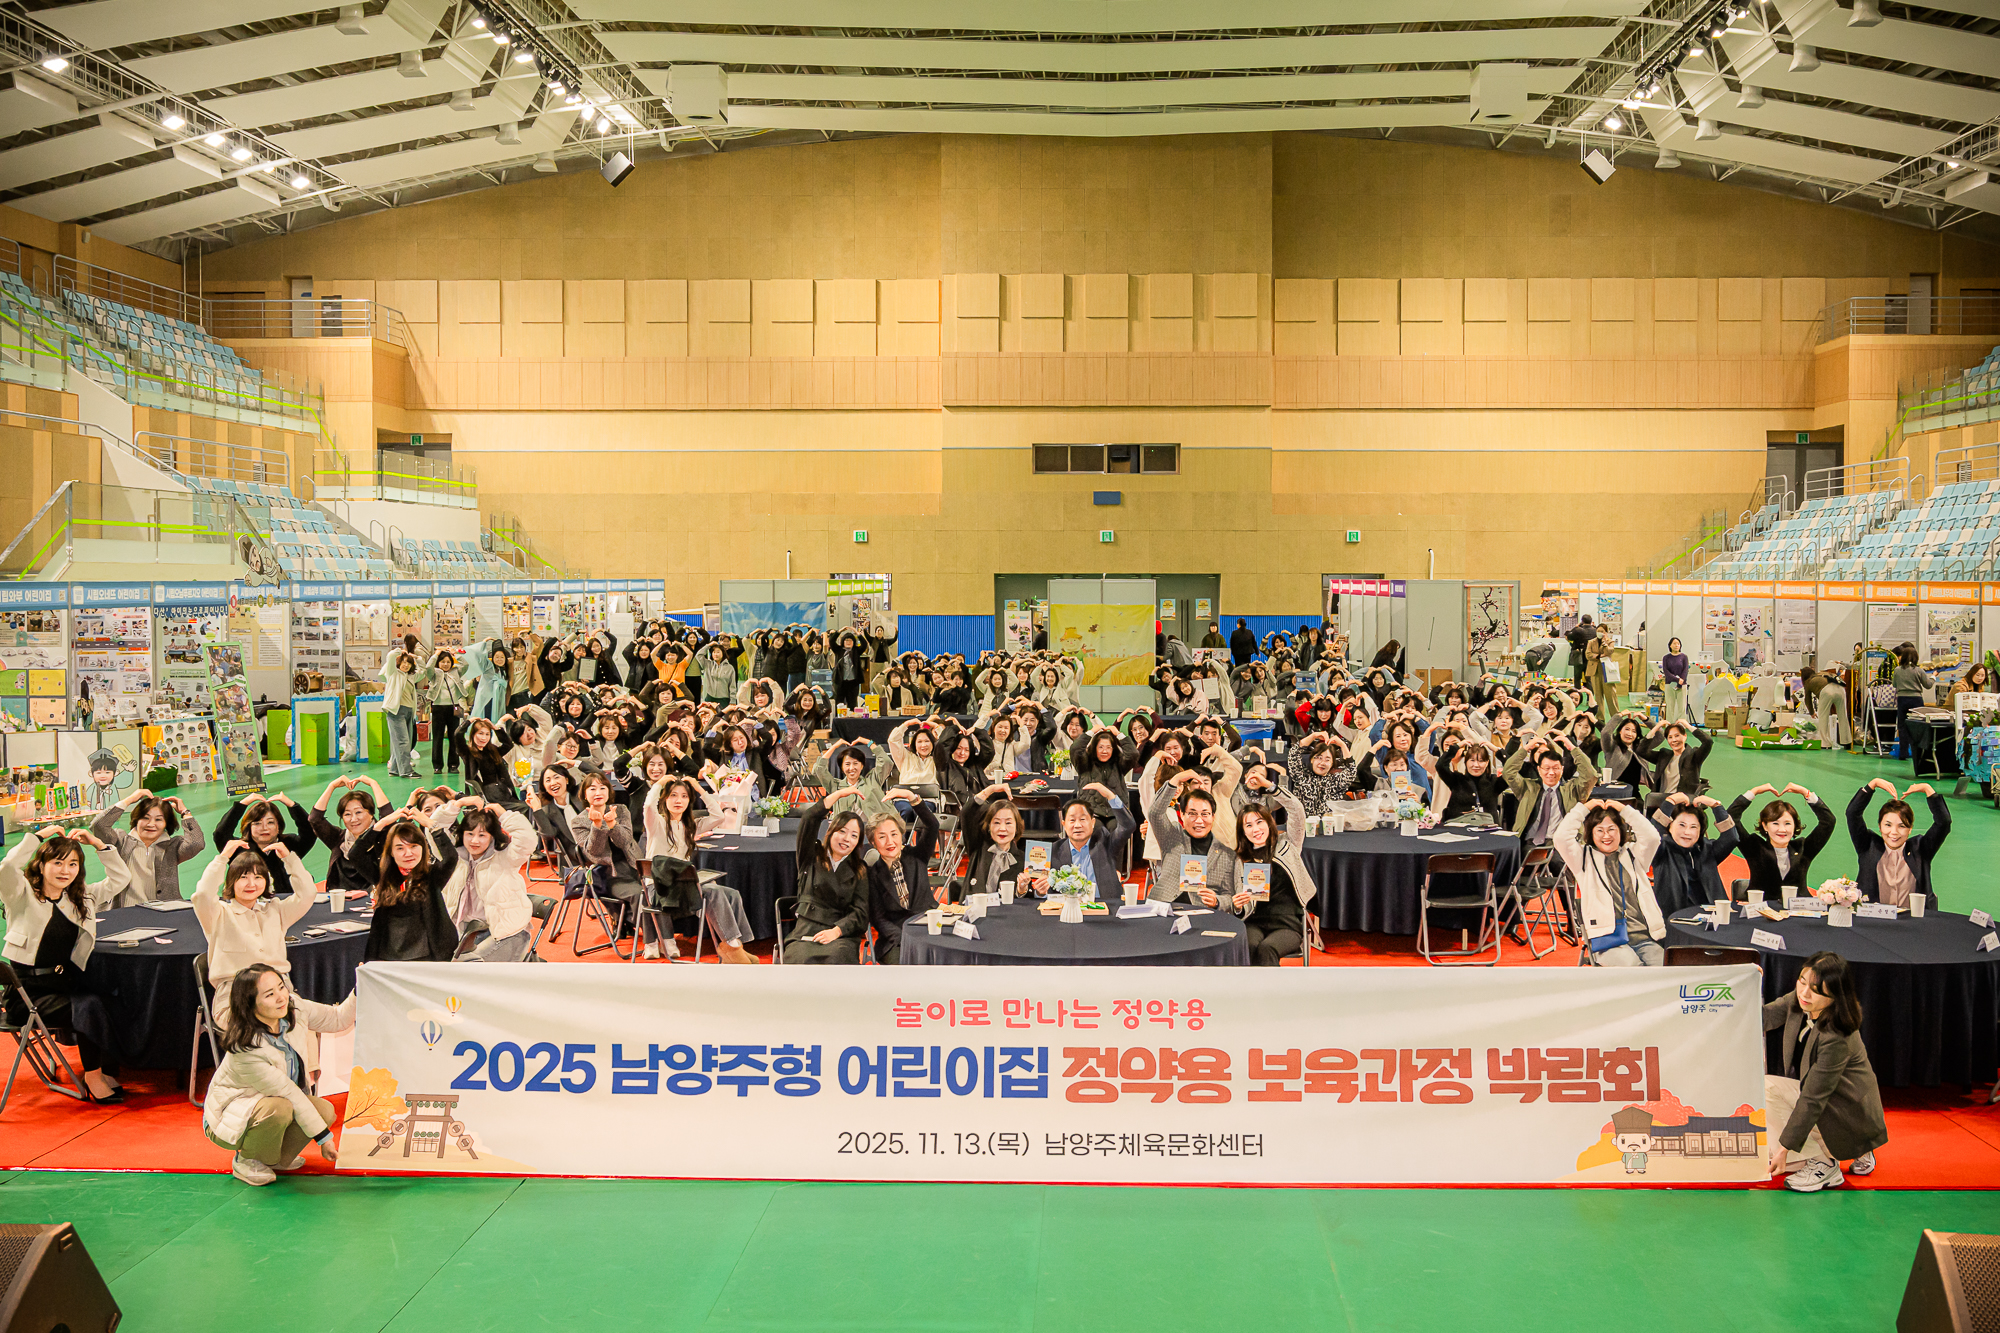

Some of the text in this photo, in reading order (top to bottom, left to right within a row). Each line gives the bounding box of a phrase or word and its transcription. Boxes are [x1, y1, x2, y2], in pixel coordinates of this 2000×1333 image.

[0, 589, 52, 603] 립와부 어린이집
[117, 589, 140, 600] 어린이집
[893, 998, 1211, 1031] 놀이로 만나는 정약용
[1681, 1004, 1706, 1014] 남양주
[451, 1041, 1660, 1104] 2025 남양주형 어린이집 정약용 보육과정 박람회
[838, 1131, 1263, 1157] 2025. 11. 13.(목) 남양주체육문화센터
